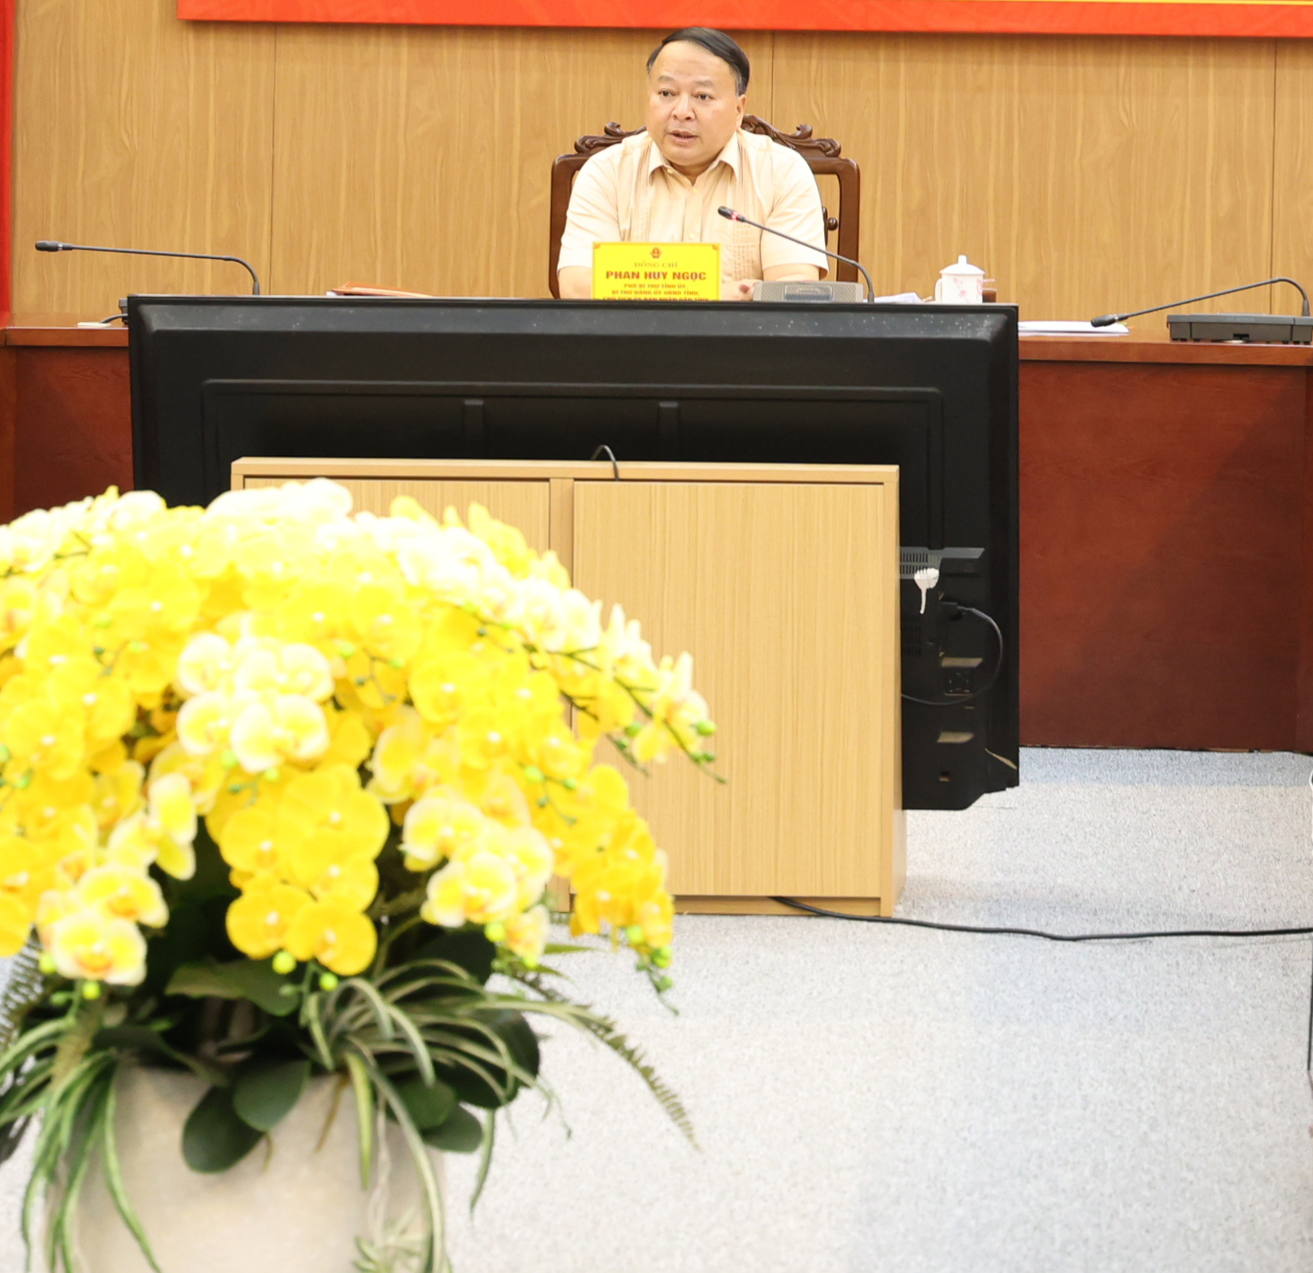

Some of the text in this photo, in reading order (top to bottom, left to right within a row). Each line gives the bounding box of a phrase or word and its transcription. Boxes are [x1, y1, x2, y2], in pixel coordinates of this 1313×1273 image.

[606, 271, 707, 282] PHAN HUY NGỌC
